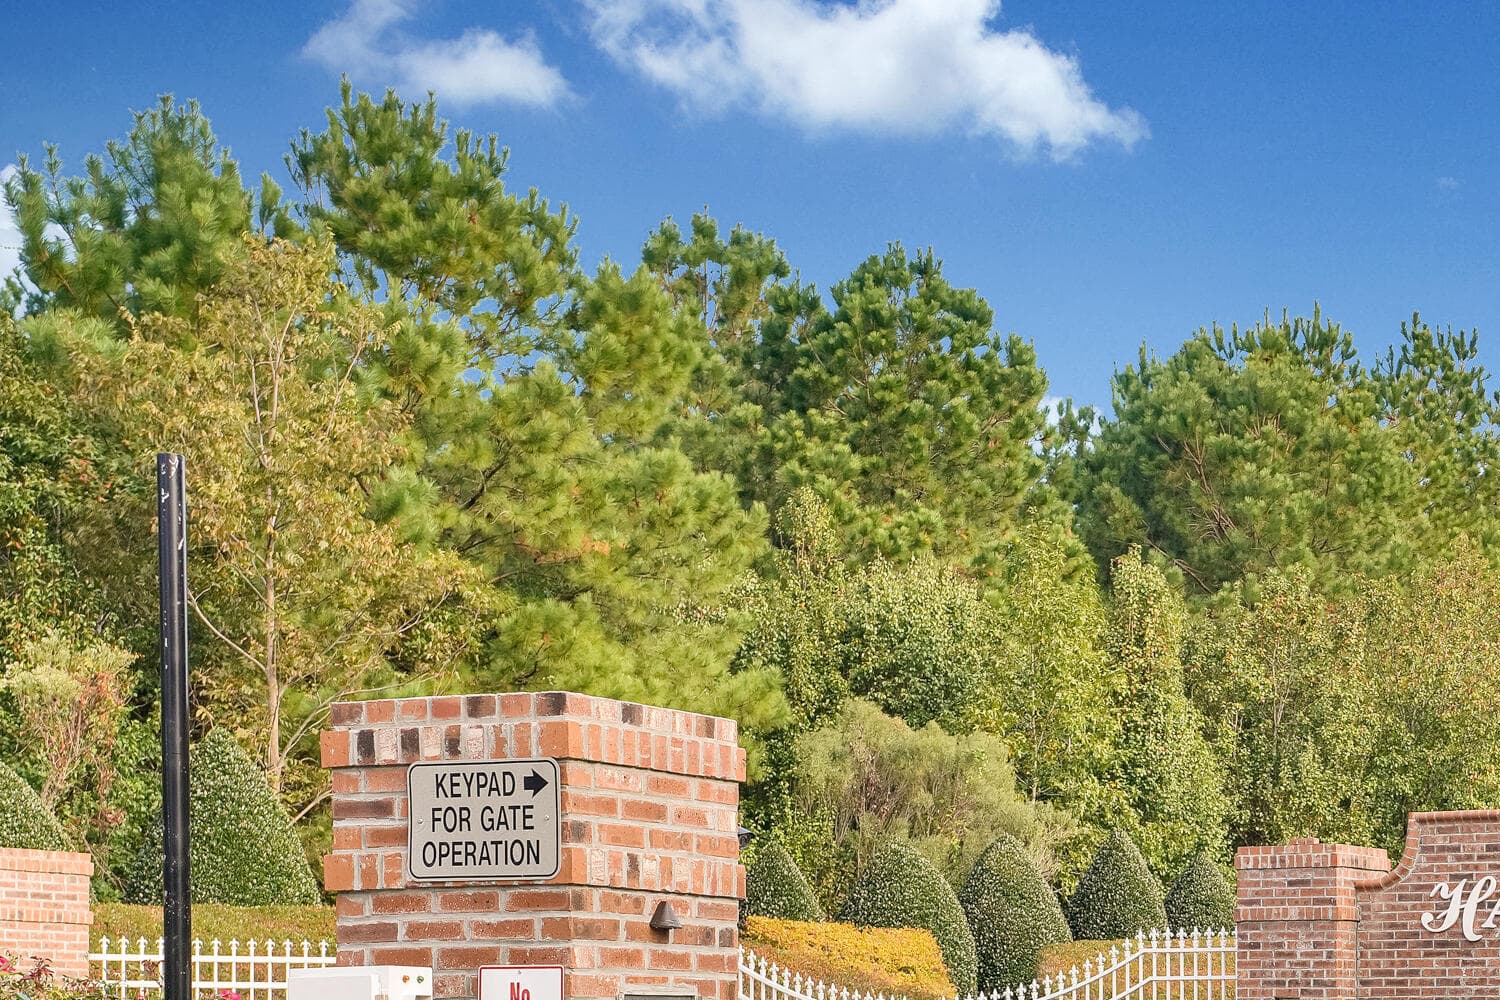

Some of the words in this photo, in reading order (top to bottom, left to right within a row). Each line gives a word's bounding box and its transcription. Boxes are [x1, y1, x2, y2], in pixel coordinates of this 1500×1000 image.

[435, 770, 515, 799] KEYPAD
[431, 806, 471, 833] FOR
[480, 804, 535, 832] GATE
[422, 839, 540, 868] OPERATION
